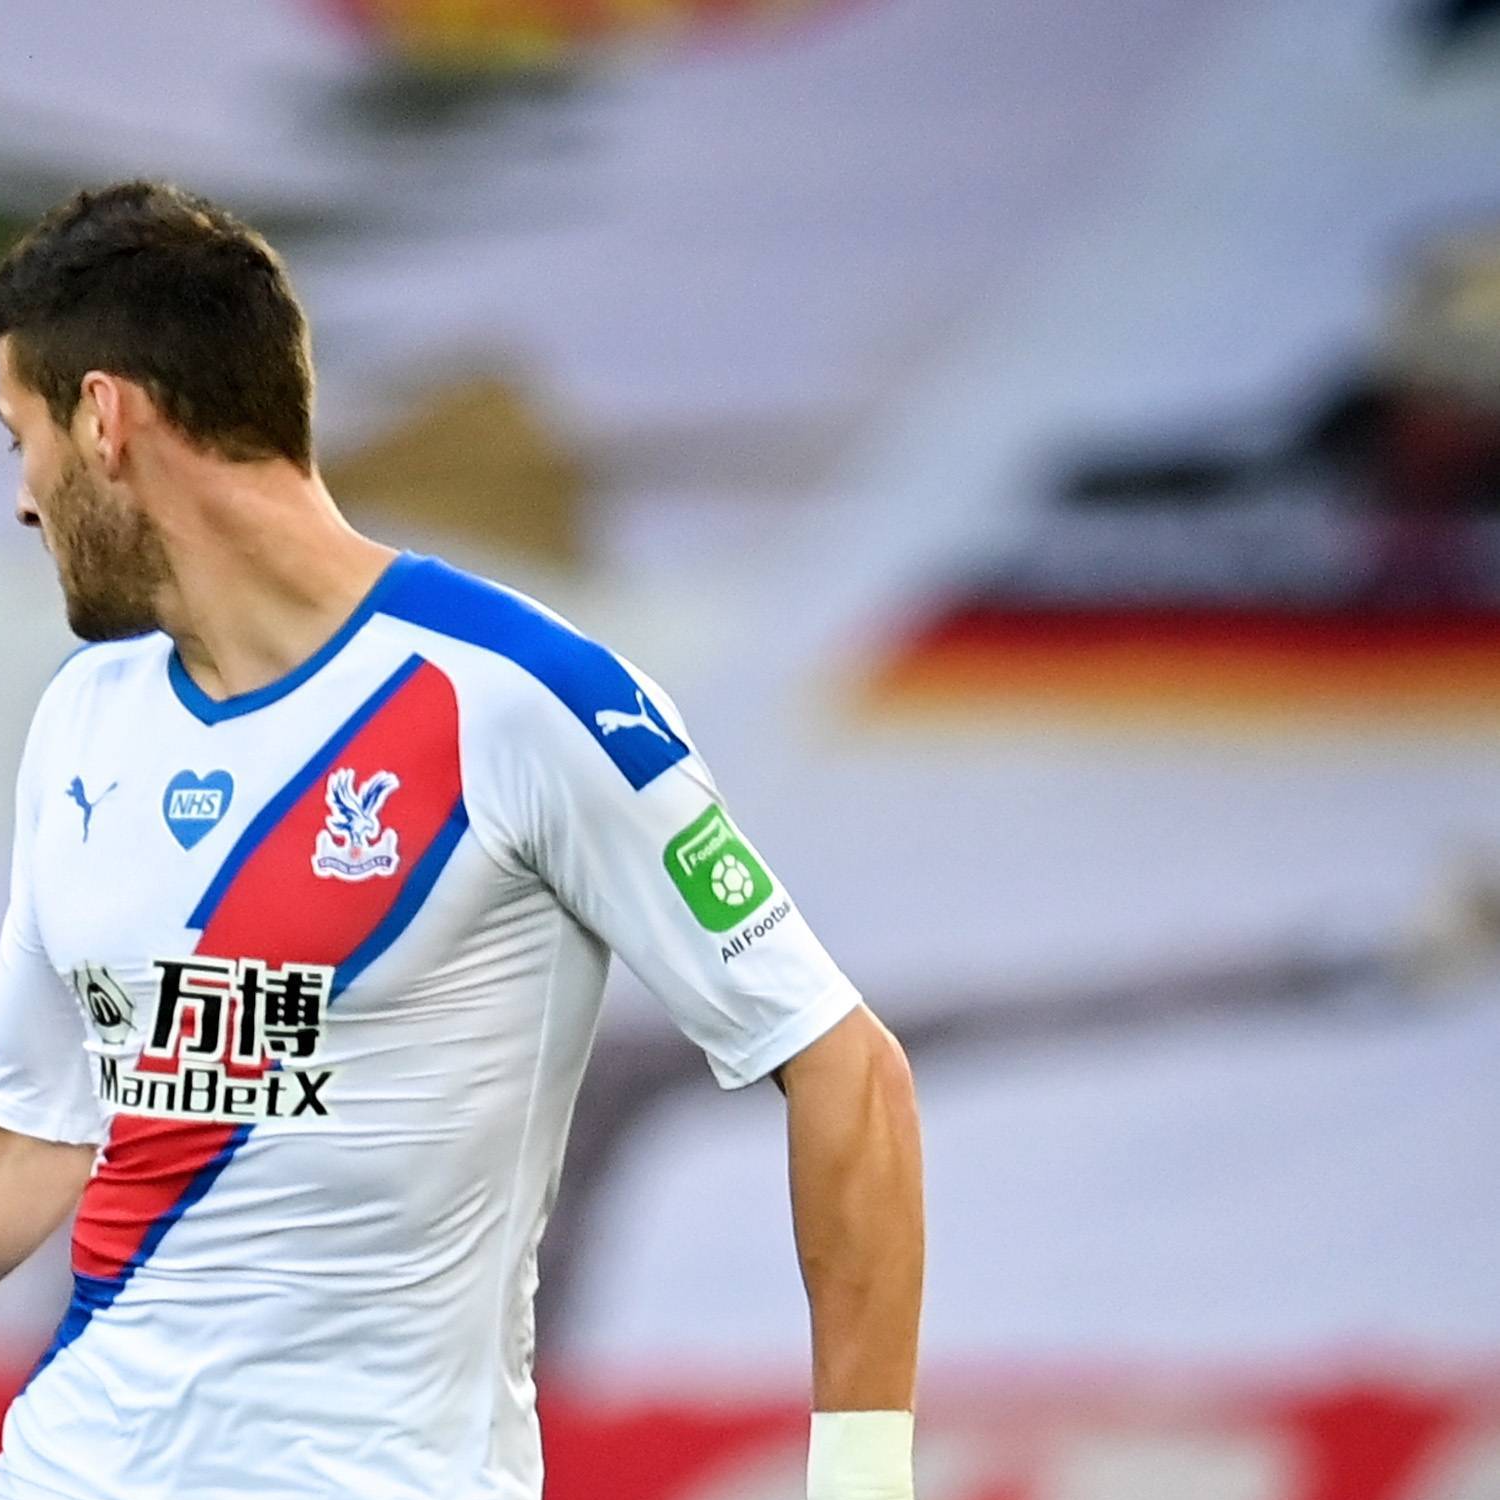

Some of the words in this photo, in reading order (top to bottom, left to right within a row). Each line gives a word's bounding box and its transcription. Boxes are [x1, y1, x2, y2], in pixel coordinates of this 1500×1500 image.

[171, 792, 220, 816] NHS
[721, 936, 745, 965] All
[151, 959, 322, 1057] 万博
[100, 1056, 332, 1117] ManBetX
